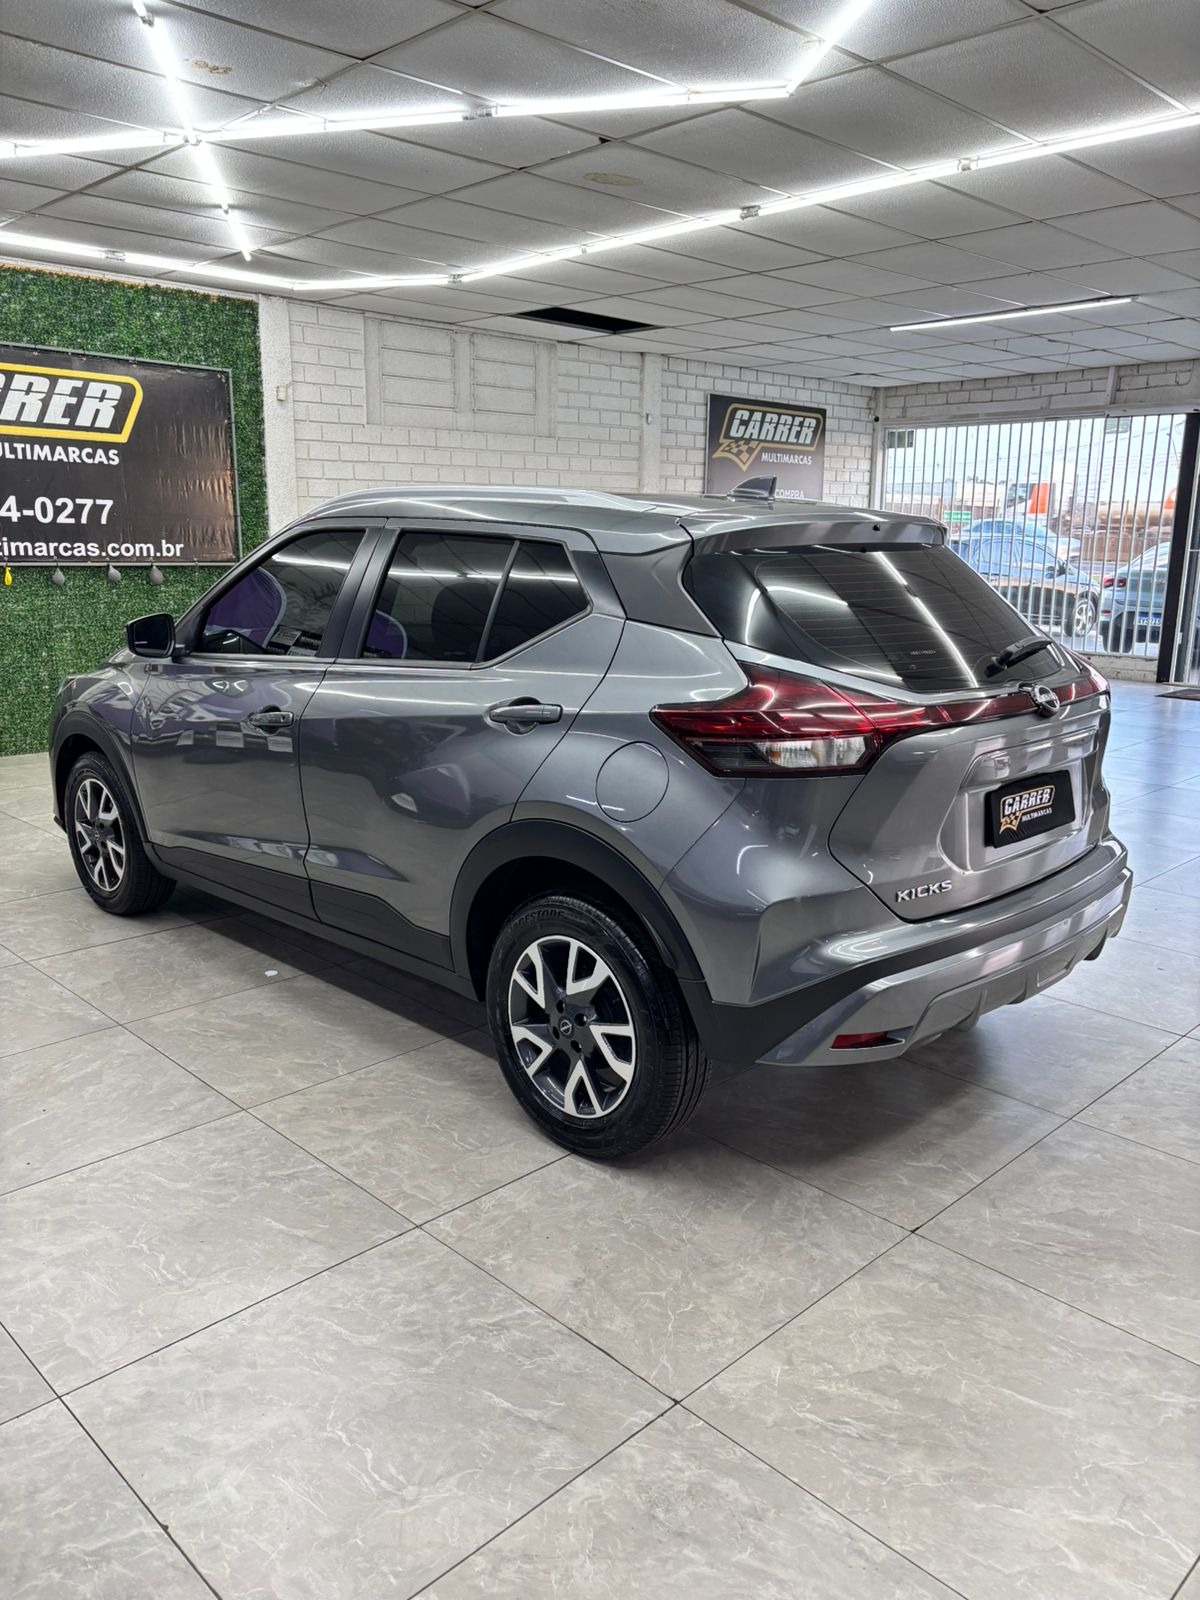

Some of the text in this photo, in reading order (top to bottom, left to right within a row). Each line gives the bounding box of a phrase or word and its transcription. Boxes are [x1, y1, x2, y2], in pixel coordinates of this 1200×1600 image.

[0, 373, 122, 428] RER
[730, 409, 817, 444] CARRER
[0, 442, 120, 466] LTIMARCAS
[761, 452, 812, 465] MULTIMARCAS
[1004, 788, 1051, 816] CARRER
[896, 880, 952, 903] KICKS
